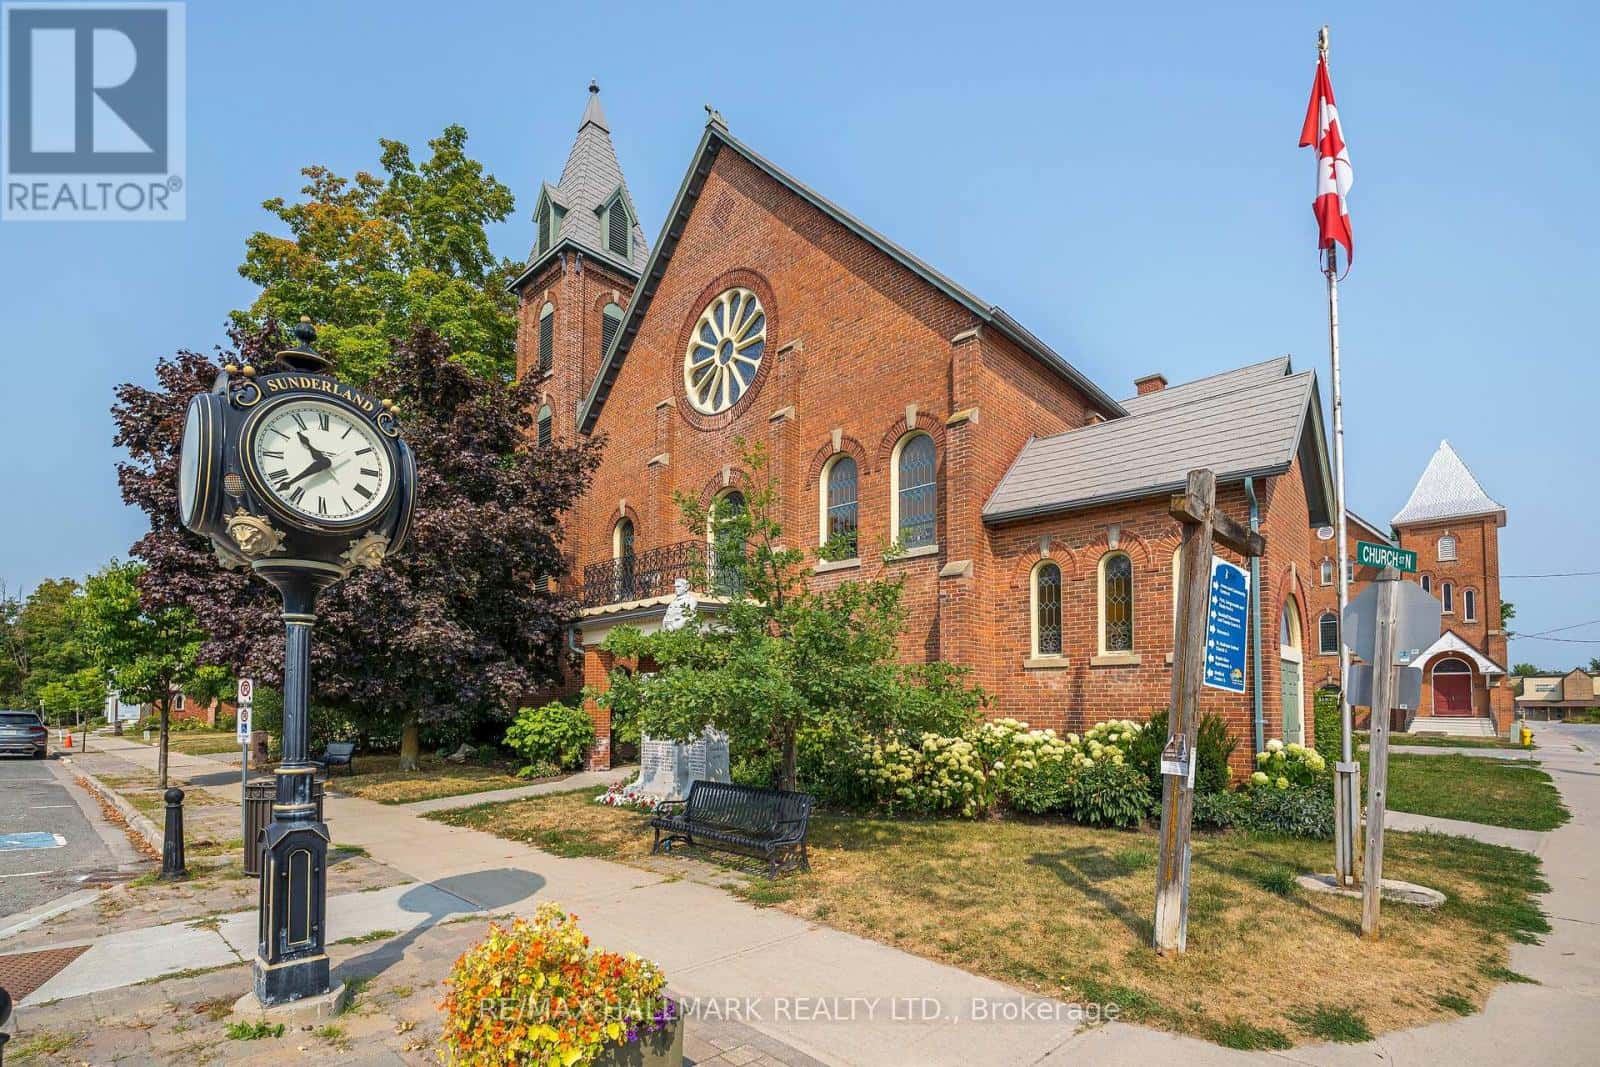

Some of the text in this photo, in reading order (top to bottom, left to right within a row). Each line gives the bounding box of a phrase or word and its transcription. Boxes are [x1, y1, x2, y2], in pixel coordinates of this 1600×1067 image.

[266, 377, 375, 412] SUNDERLAND
[1362, 545, 1399, 567] CHURCH
[1405, 554, 1412, 569] N
